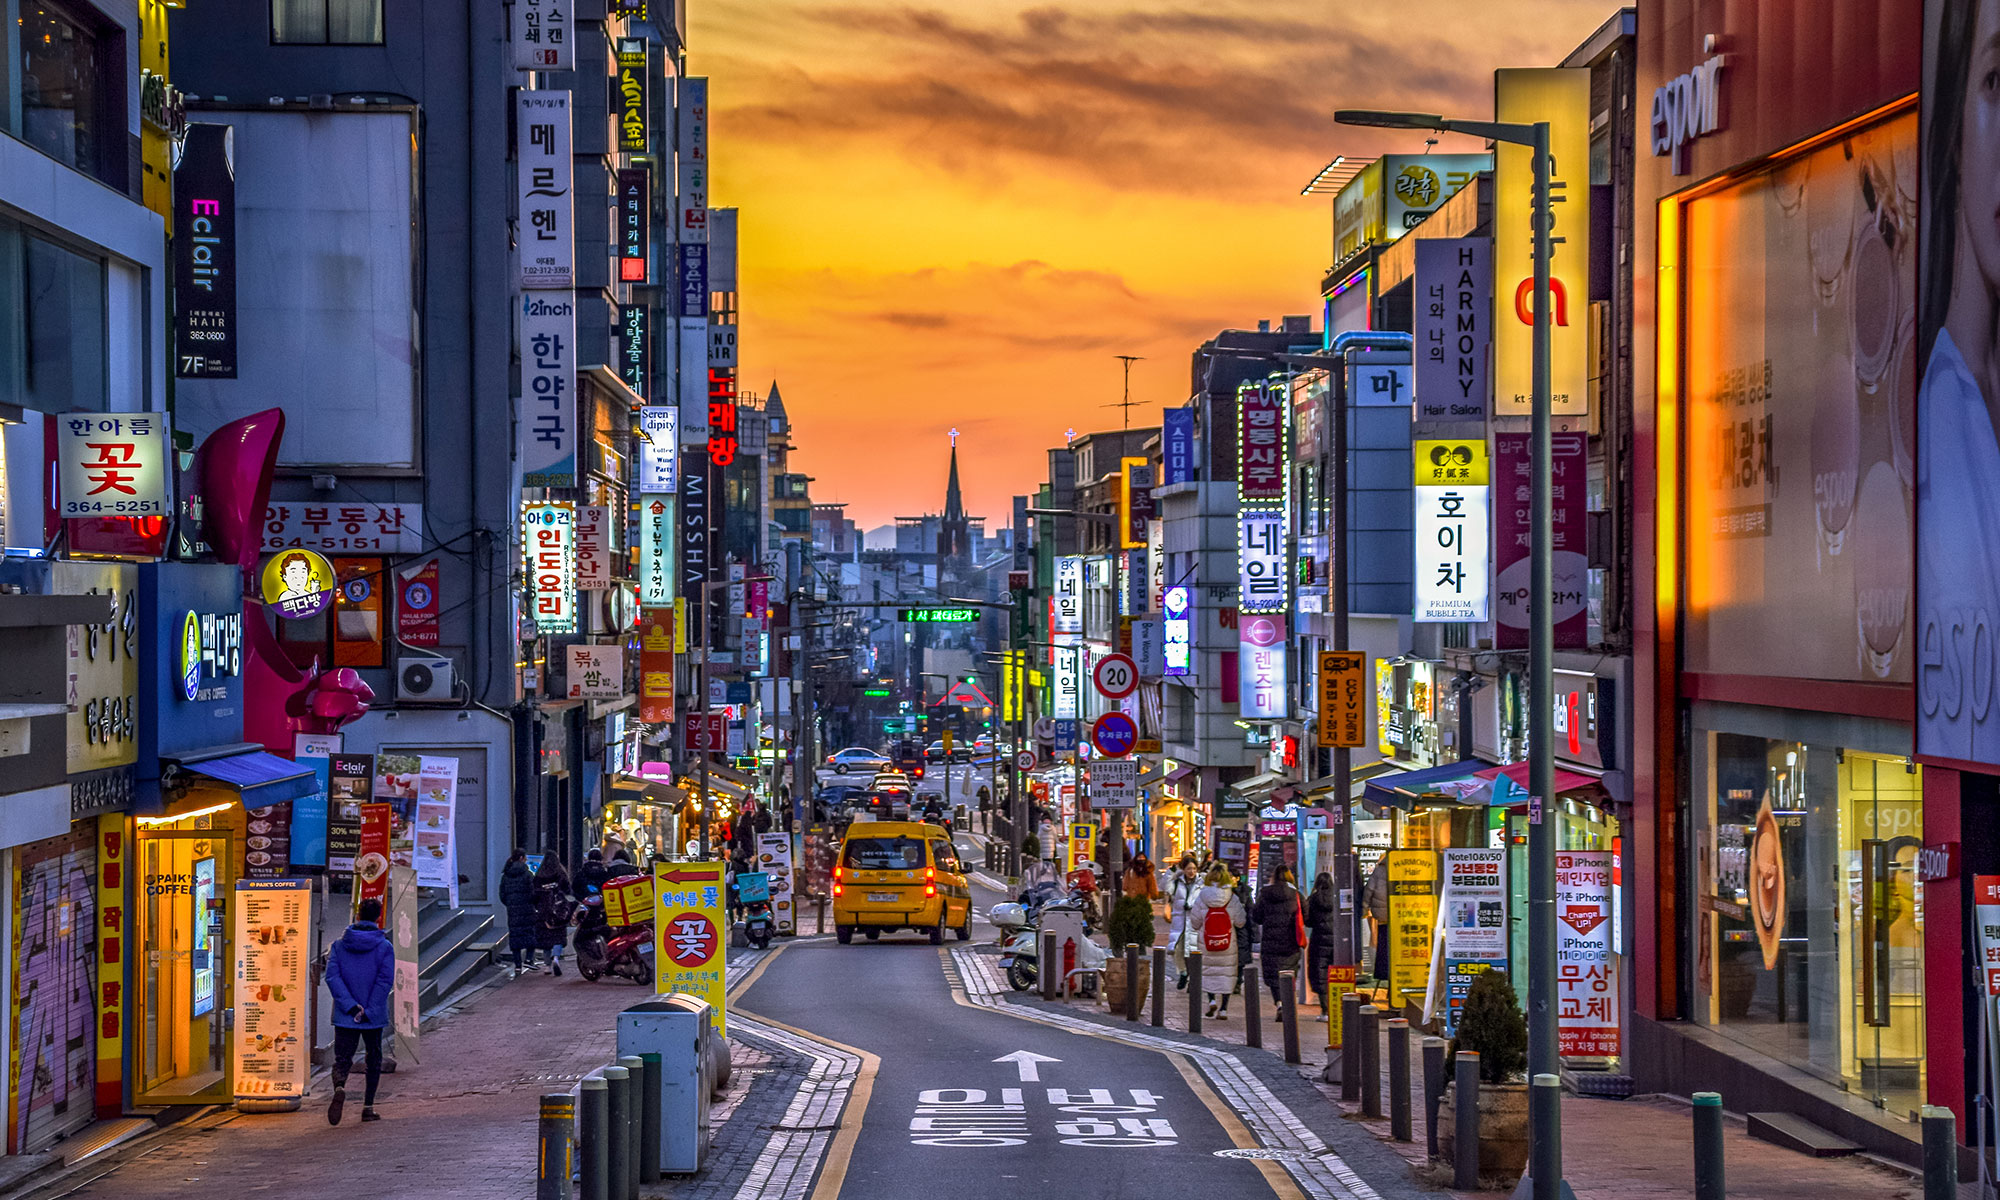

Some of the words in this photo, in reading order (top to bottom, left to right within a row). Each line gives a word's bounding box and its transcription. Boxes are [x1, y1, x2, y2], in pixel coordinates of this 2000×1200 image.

[1651, 34, 1725, 176] espoir
[529, 123, 558, 241] 메르헨
[627, 185, 639, 257] 스터디카페
[192, 199, 221, 292] Eclair
[1429, 284, 1446, 320] 너와
[190, 318, 226, 327] HAIR
[1457, 247, 1475, 398] HARMONY
[190, 331, 226, 340] 362-0600
[1429, 327, 1446, 364] 나의
[181, 356, 204, 374] 7F
[531, 332, 565, 450] 한약국
[708, 369, 738, 466] 노래방
[1424, 404, 1445, 415] Hair
[1450, 404, 1482, 415] Salon
[68, 418, 153, 437] 한아름
[647, 420, 676, 431] dipity
[684, 425, 706, 433] Flora
[1246, 410, 1278, 483] 명동사주
[80, 442, 142, 496] 꽃
[66, 500, 160, 513] 364-5251
[686, 474, 704, 582] MISSHA
[1436, 492, 1466, 594] 호이차
[1246, 523, 1281, 594] 네일
[537, 529, 562, 615] 인도요리
[1060, 578, 1077, 617] 네일
[1425, 610, 1457, 618] BUBBLE
[1460, 610, 1476, 618] TEA
[1107, 668, 1127, 686] 20
[1254, 651, 1273, 712] 렌즈미
[1098, 730, 1132, 739] 주차금지
[336, 760, 366, 772] Eclair
[1020, 757, 1031, 766] 20
[331, 828, 347, 836] 30%
[330, 841, 345, 849] 50%
[1393, 859, 1433, 868] HARMONY
[1448, 853, 1502, 861] Note10&V50
[1557, 857, 1570, 867] kt
[1575, 857, 1610, 868] iPhone
[1453, 864, 1498, 874] 2년동안
[157, 873, 198, 885] PAIK'S
[256, 881, 274, 889] PAIK'S
[1556, 871, 1610, 887] 체인지업
[662, 892, 698, 908] 한아름
[702, 886, 720, 909] 꽃
[1575, 892, 1611, 903] iPhone
[1568, 911, 1598, 919] Change
[1577, 920, 1592, 929] UP!
[670, 919, 712, 960] 꽃
[1564, 937, 1604, 949] iPhone
[1558, 965, 1612, 992] 무상
[1558, 997, 1612, 1023] 교체
